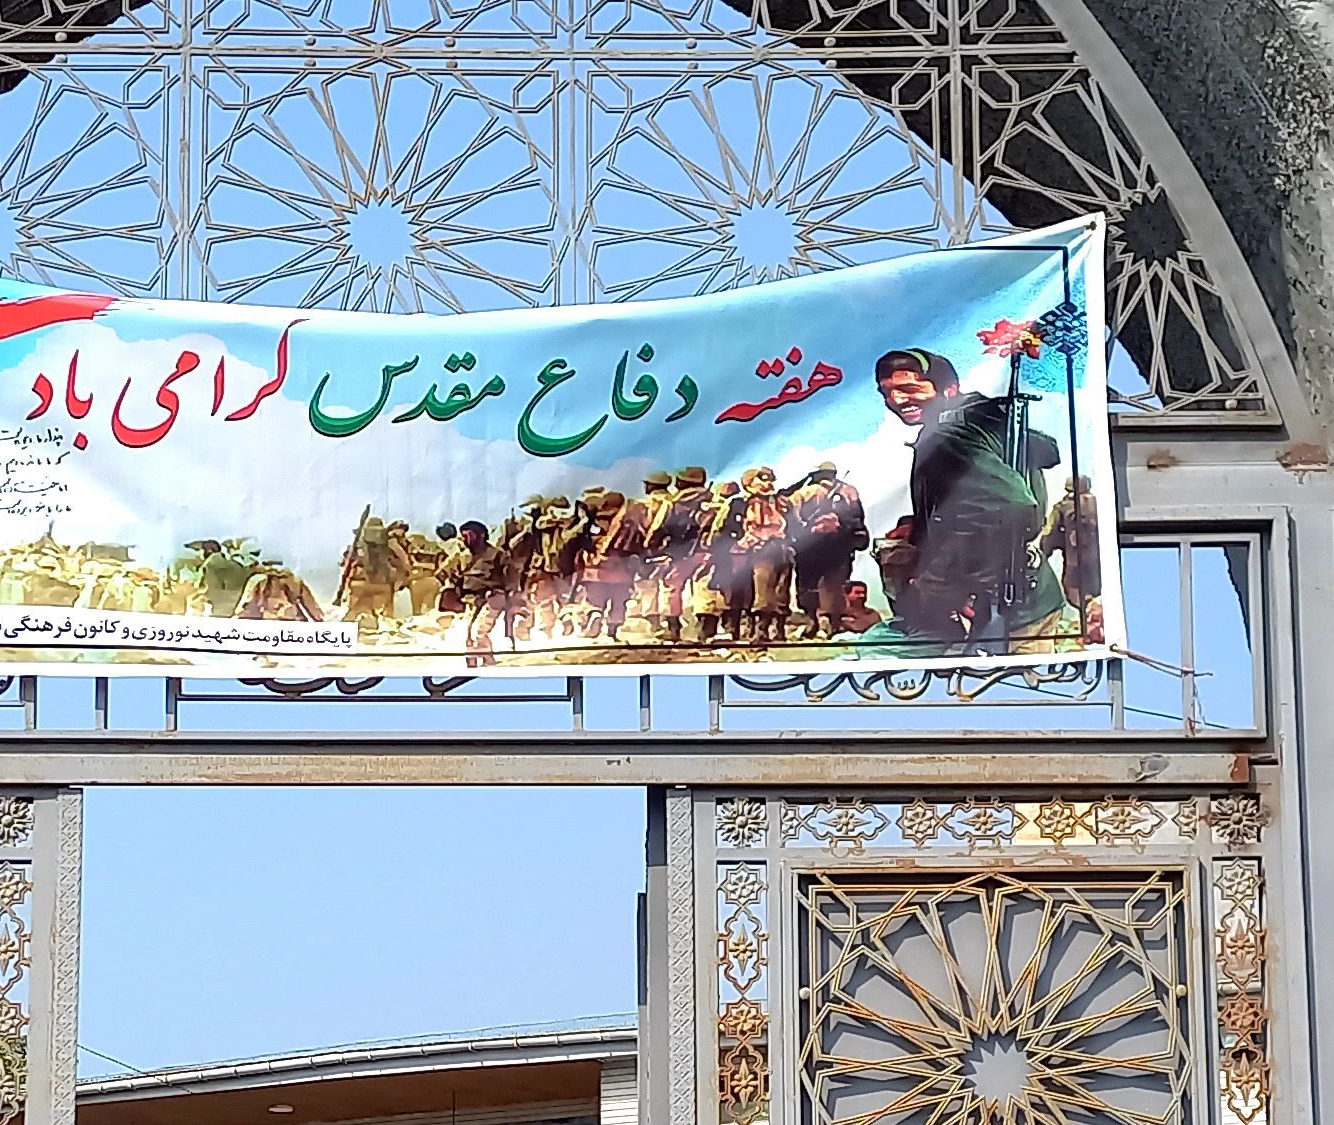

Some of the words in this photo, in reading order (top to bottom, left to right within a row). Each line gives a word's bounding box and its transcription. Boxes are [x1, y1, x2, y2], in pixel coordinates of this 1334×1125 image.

[308, 352, 506, 438] مقدس
[714, 346, 844, 425] هفته
[25, 349, 94, 451] باد
[517, 343, 699, 457] دفاع
[3, 614, 72, 639] فرهنگی
[73, 619, 121, 639] کانون
[120, 626, 130, 639] و
[131, 625, 190, 642] نوروزی
[191, 627, 241, 644] شهید
[242, 629, 304, 647] مقاومت
[306, 629, 352, 649] پایگاه
